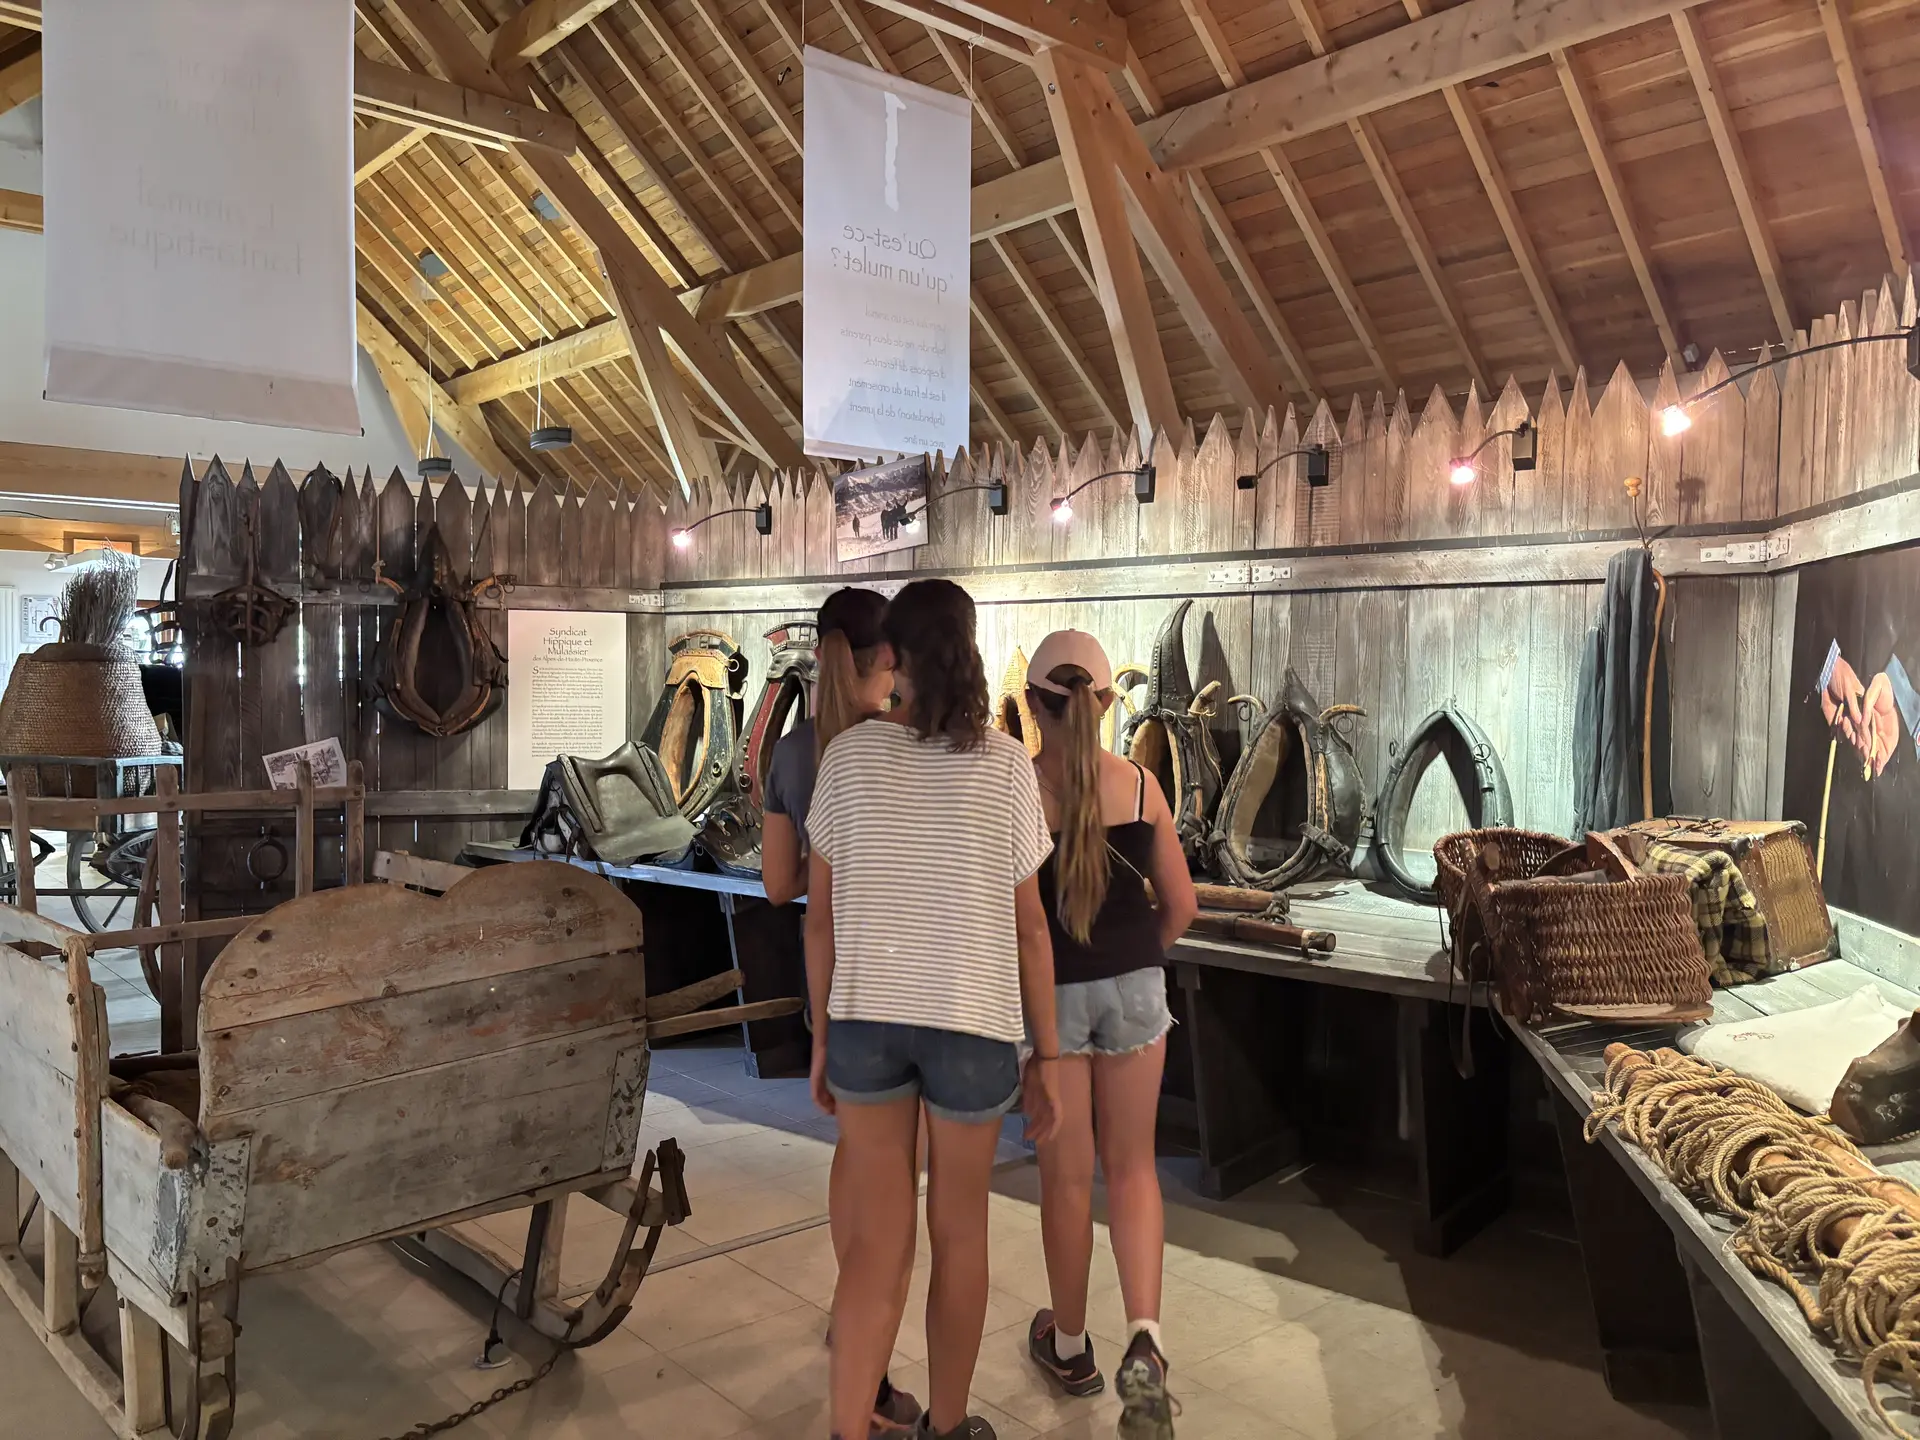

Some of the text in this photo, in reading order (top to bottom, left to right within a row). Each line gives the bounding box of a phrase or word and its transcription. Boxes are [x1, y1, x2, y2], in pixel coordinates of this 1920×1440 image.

[549, 625, 587, 639] Syndicat
[543, 637, 593, 651] Hippique et
[547, 644, 588, 656] Mulassier
